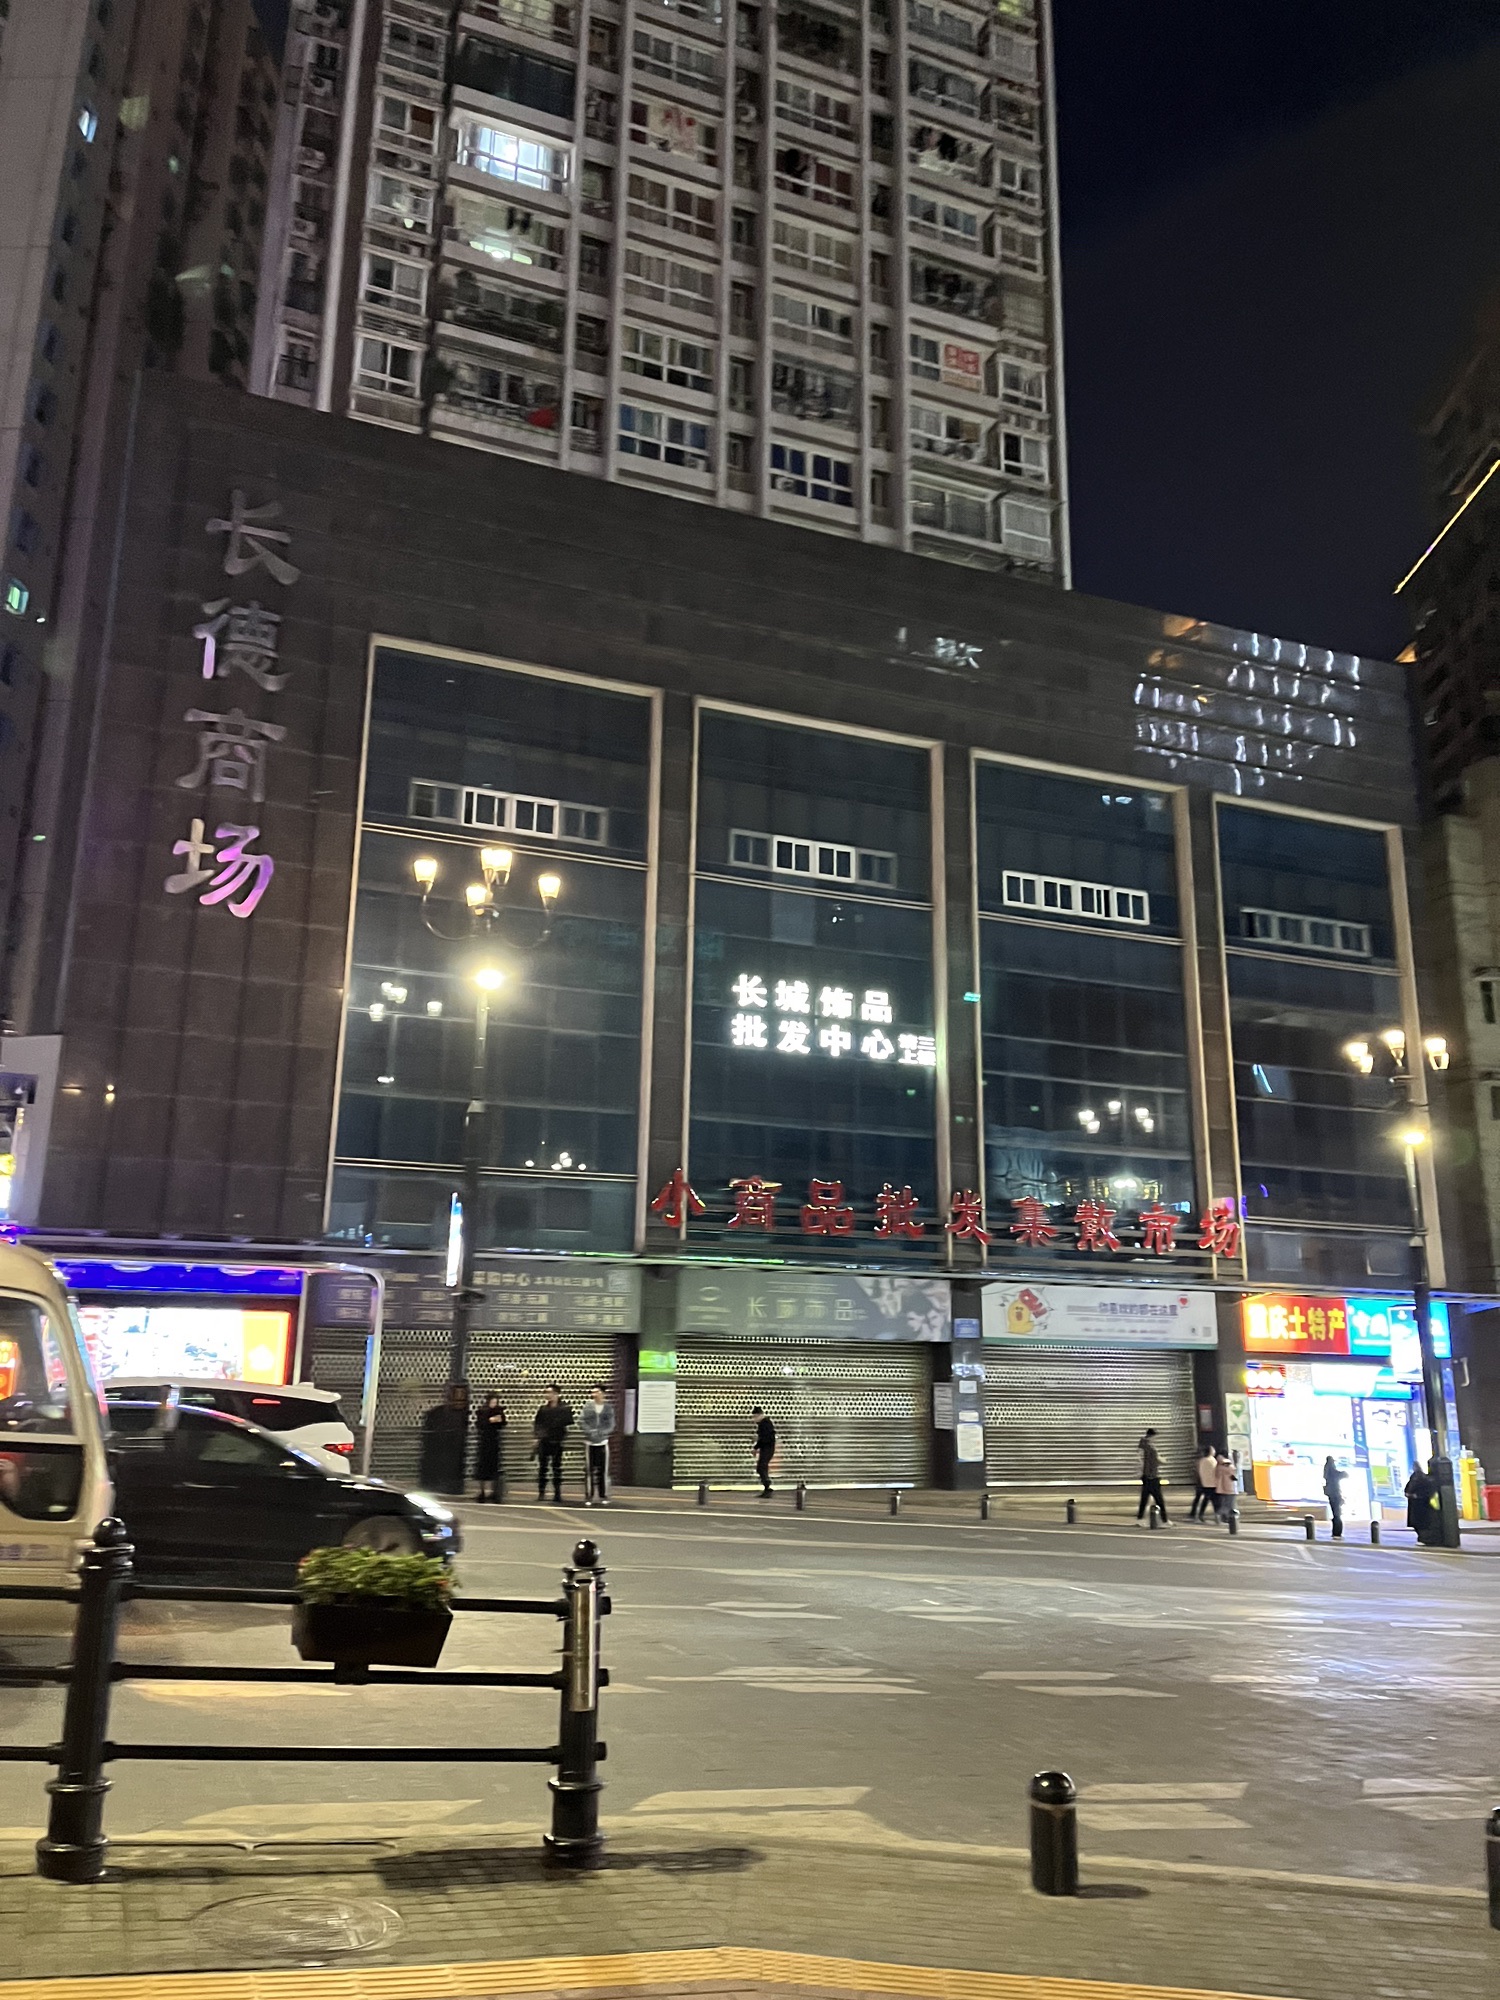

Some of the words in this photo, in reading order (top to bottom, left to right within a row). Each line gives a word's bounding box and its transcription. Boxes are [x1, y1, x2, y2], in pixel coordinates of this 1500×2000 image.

[164, 490, 300, 918] 长德商场
[731, 973, 893, 1024] 长城饰品
[731, 1013, 895, 1060] 批发中心
[651, 1168, 1241, 1258] 小商品批发集散市场
[1247, 1303, 1346, 1341] 重庆土特产
